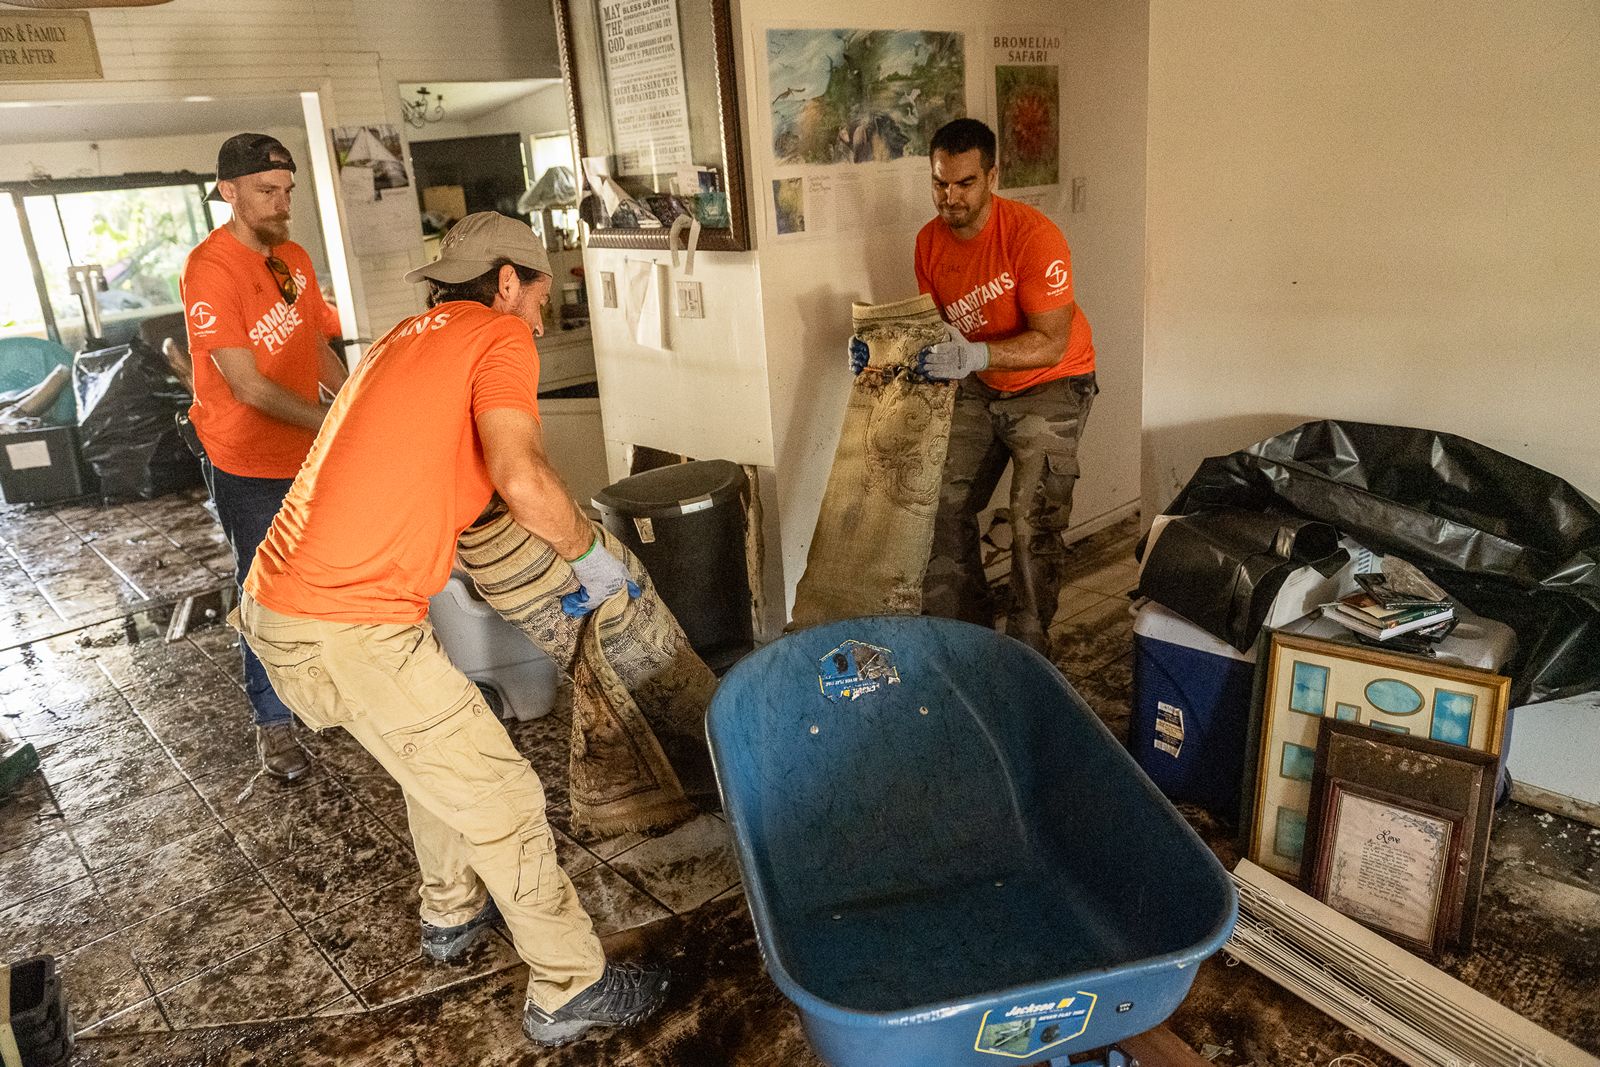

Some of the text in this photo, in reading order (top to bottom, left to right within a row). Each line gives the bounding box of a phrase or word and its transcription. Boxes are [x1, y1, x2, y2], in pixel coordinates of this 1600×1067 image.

[603, 3, 621, 21] MAY
[622, 2, 641, 14] BLESS
[642, 0, 651, 8] US
[0, 26, 14, 41] DS
[26, 23, 66, 41] FAMILY
[605, 19, 623, 37] THE
[607, 35, 625, 53] GOD
[993, 36, 1060, 48] BROMELIAD
[0, 46, 57, 65] ER AFTER
[1008, 50, 1048, 62] SAFARI
[1005, 1002, 1056, 1017] Jackson
